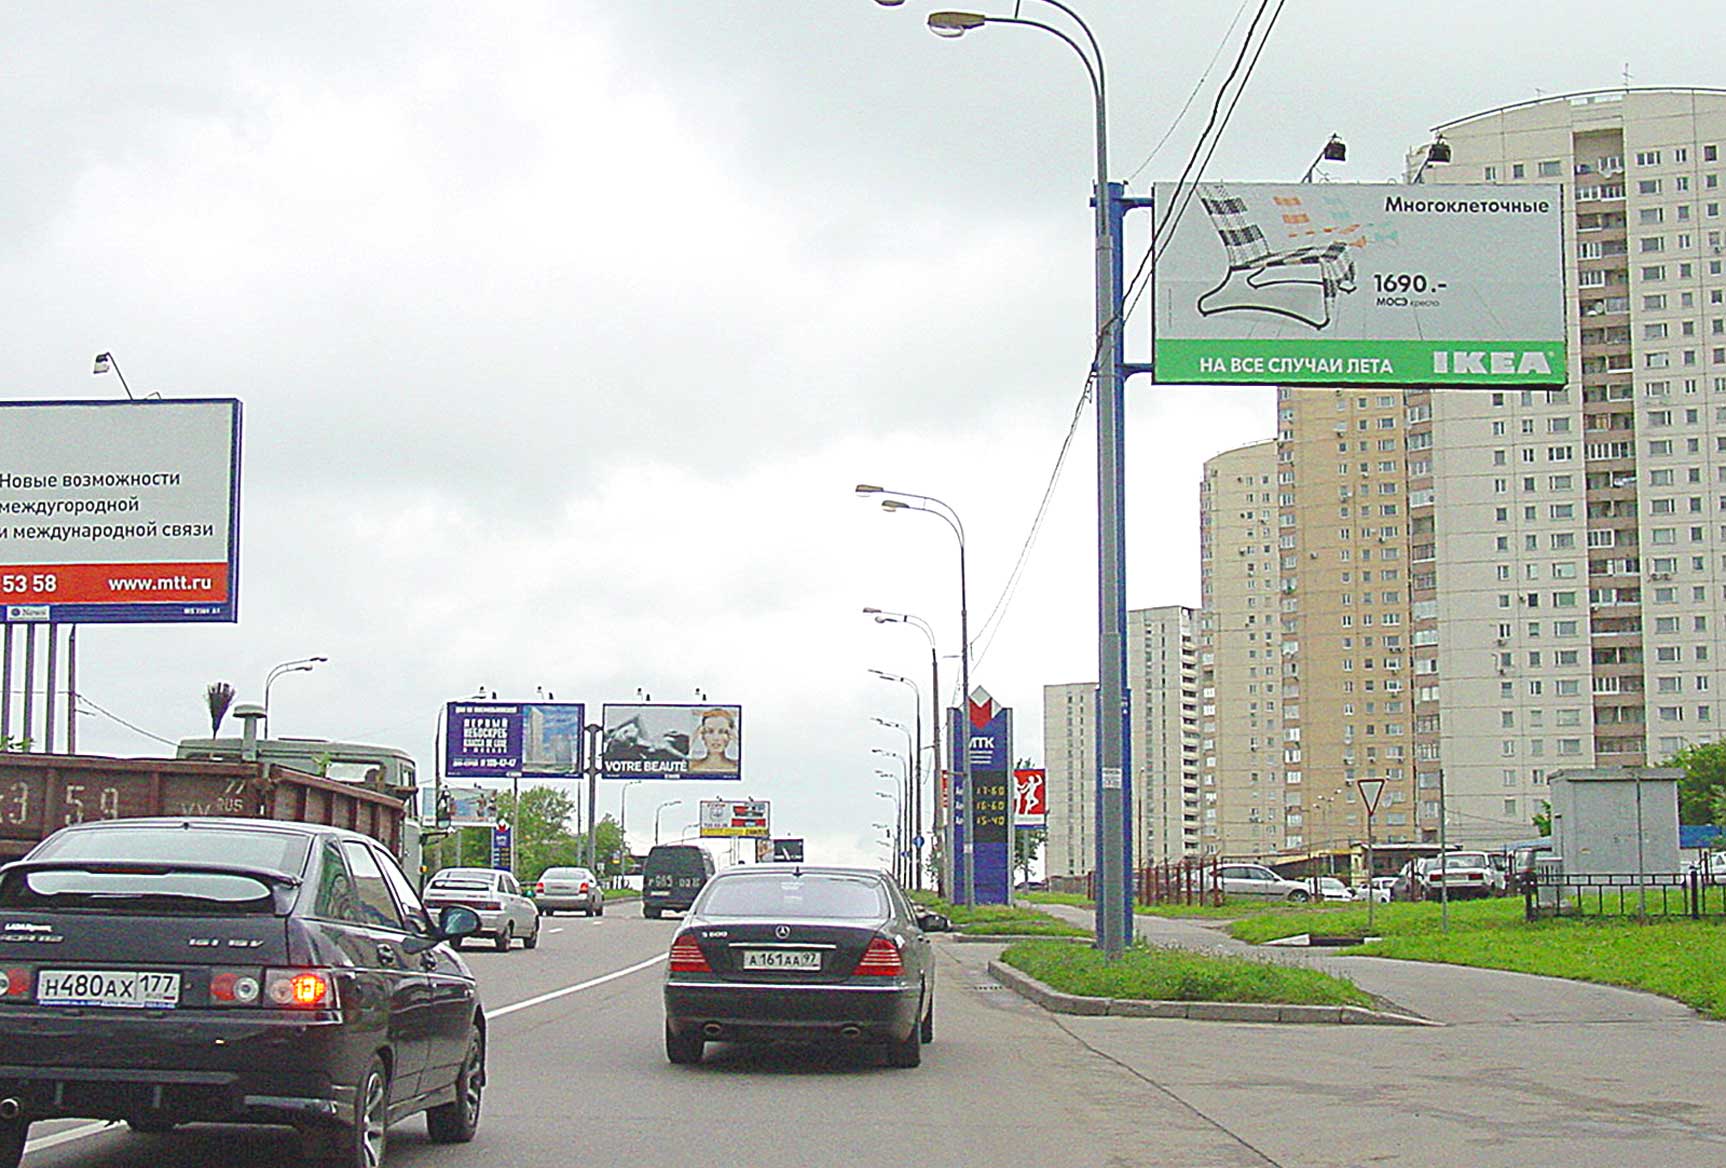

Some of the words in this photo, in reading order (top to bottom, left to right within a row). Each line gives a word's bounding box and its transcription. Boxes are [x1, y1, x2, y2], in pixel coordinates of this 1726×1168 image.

[1385, 196, 1549, 213] Многоклеточные
[1199, 357, 1226, 373] НА
[1231, 357, 1264, 373] ВСЕ
[1346, 358, 1393, 374] ЛЕТА
[1432, 350, 1552, 375] IKEA
[0, 473, 57, 488] Новые
[63, 473, 180, 487] возможности
[0, 496, 139, 515] междугородной
[14, 521, 156, 540] международной
[162, 524, 213, 537] связи
[2, 575, 26, 593] 53
[33, 575, 57, 592] 58
[108, 577, 212, 591] www.mtt.ru
[604, 761, 642, 772] VOTRE
[140, 976, 174, 993] 177
